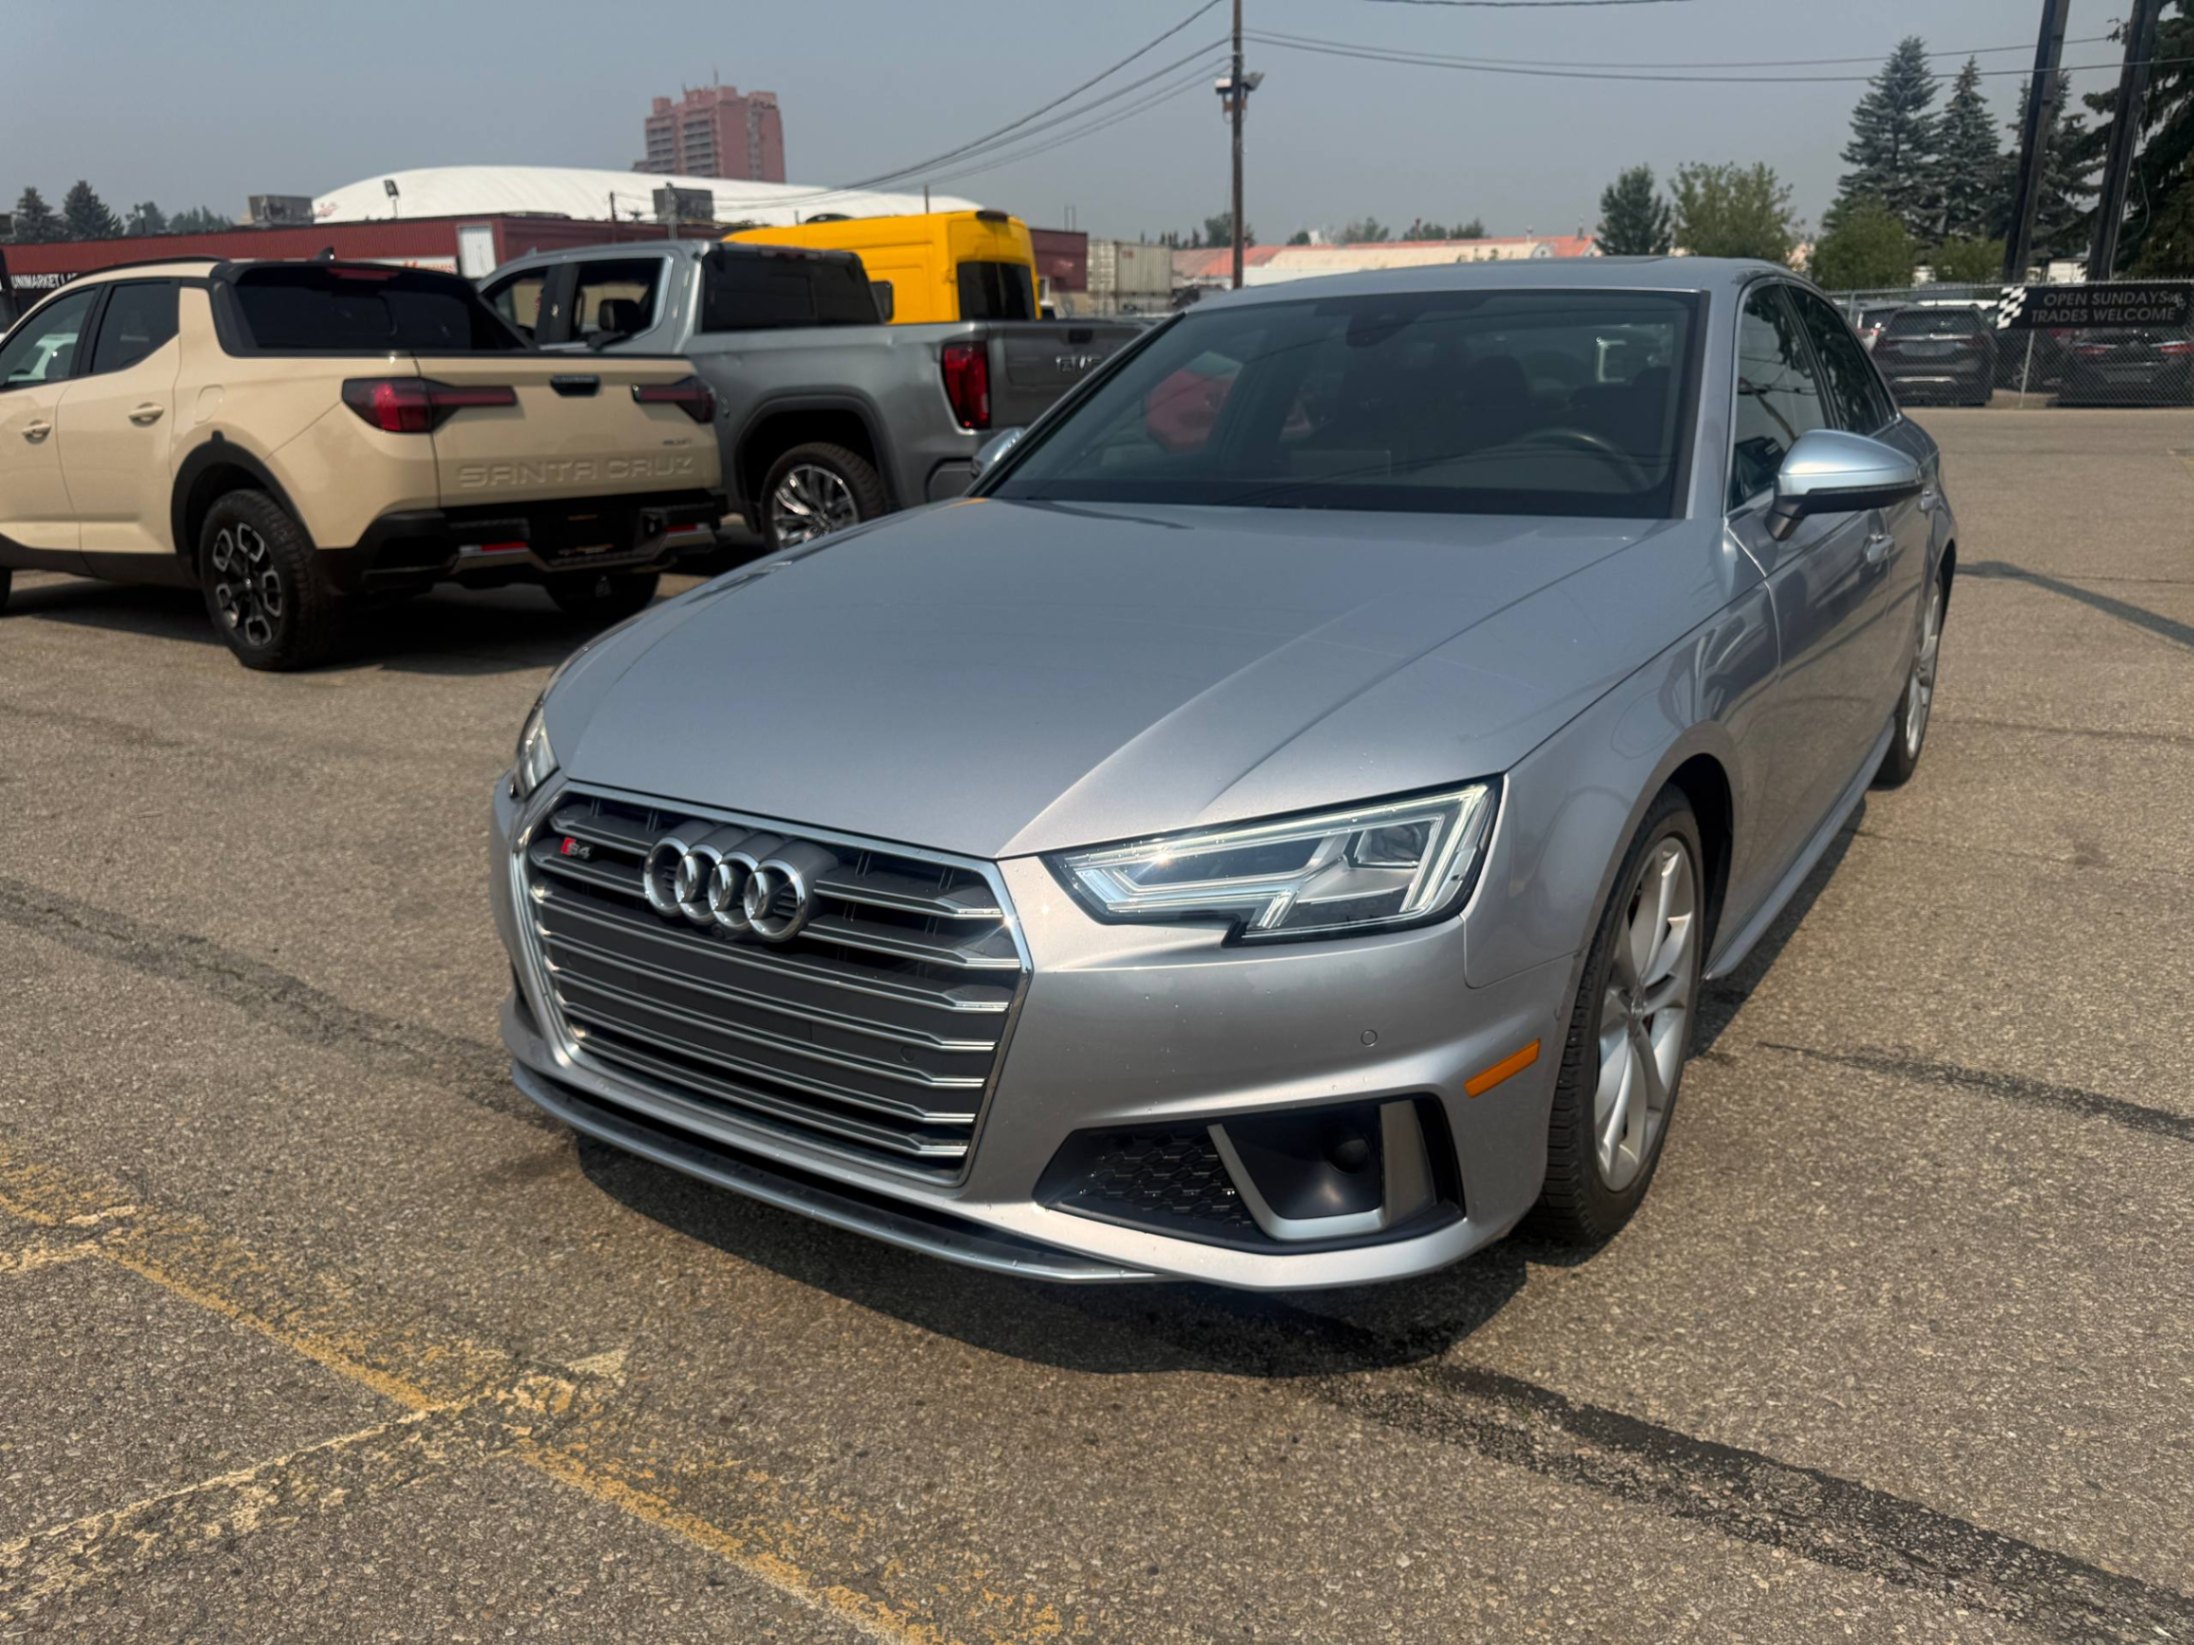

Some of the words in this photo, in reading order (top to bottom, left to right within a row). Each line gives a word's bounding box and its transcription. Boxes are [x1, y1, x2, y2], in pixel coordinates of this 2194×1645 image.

[2043, 293, 2088, 307] OPEN
[2092, 291, 2168, 306] SUNDAYS
[2031, 308, 2089, 323] TRADES
[2093, 306, 2177, 322] WELCOME
[459, 459, 598, 489] SANTA
[607, 455, 695, 480] CRUZ
